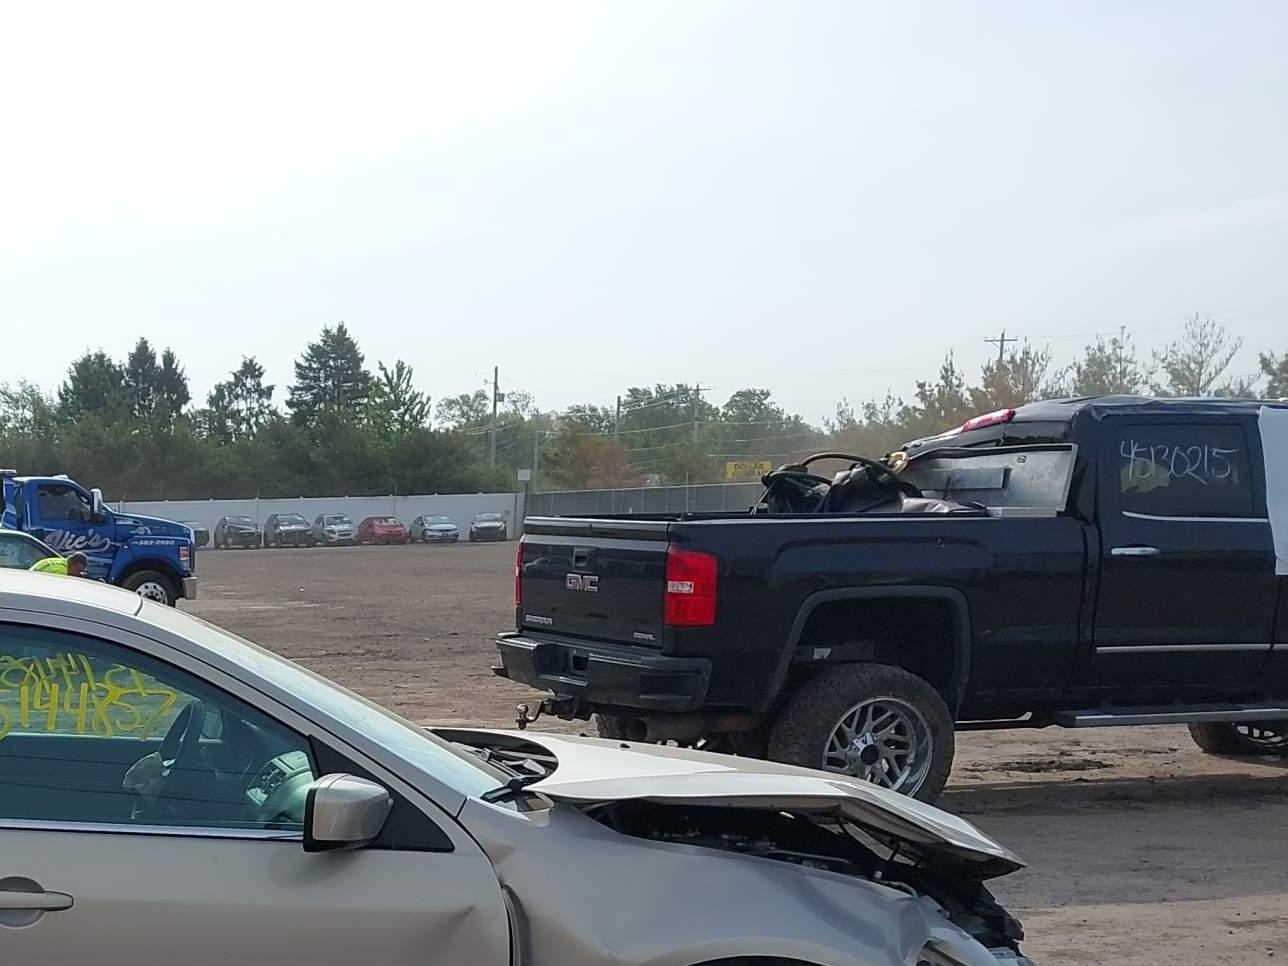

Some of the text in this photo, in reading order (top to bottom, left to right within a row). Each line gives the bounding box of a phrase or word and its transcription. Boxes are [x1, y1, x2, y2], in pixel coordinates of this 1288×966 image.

[1119, 439, 1240, 486] 45130215
[43, 528, 106, 552] Vic's
[566, 573, 599, 592] GMC
